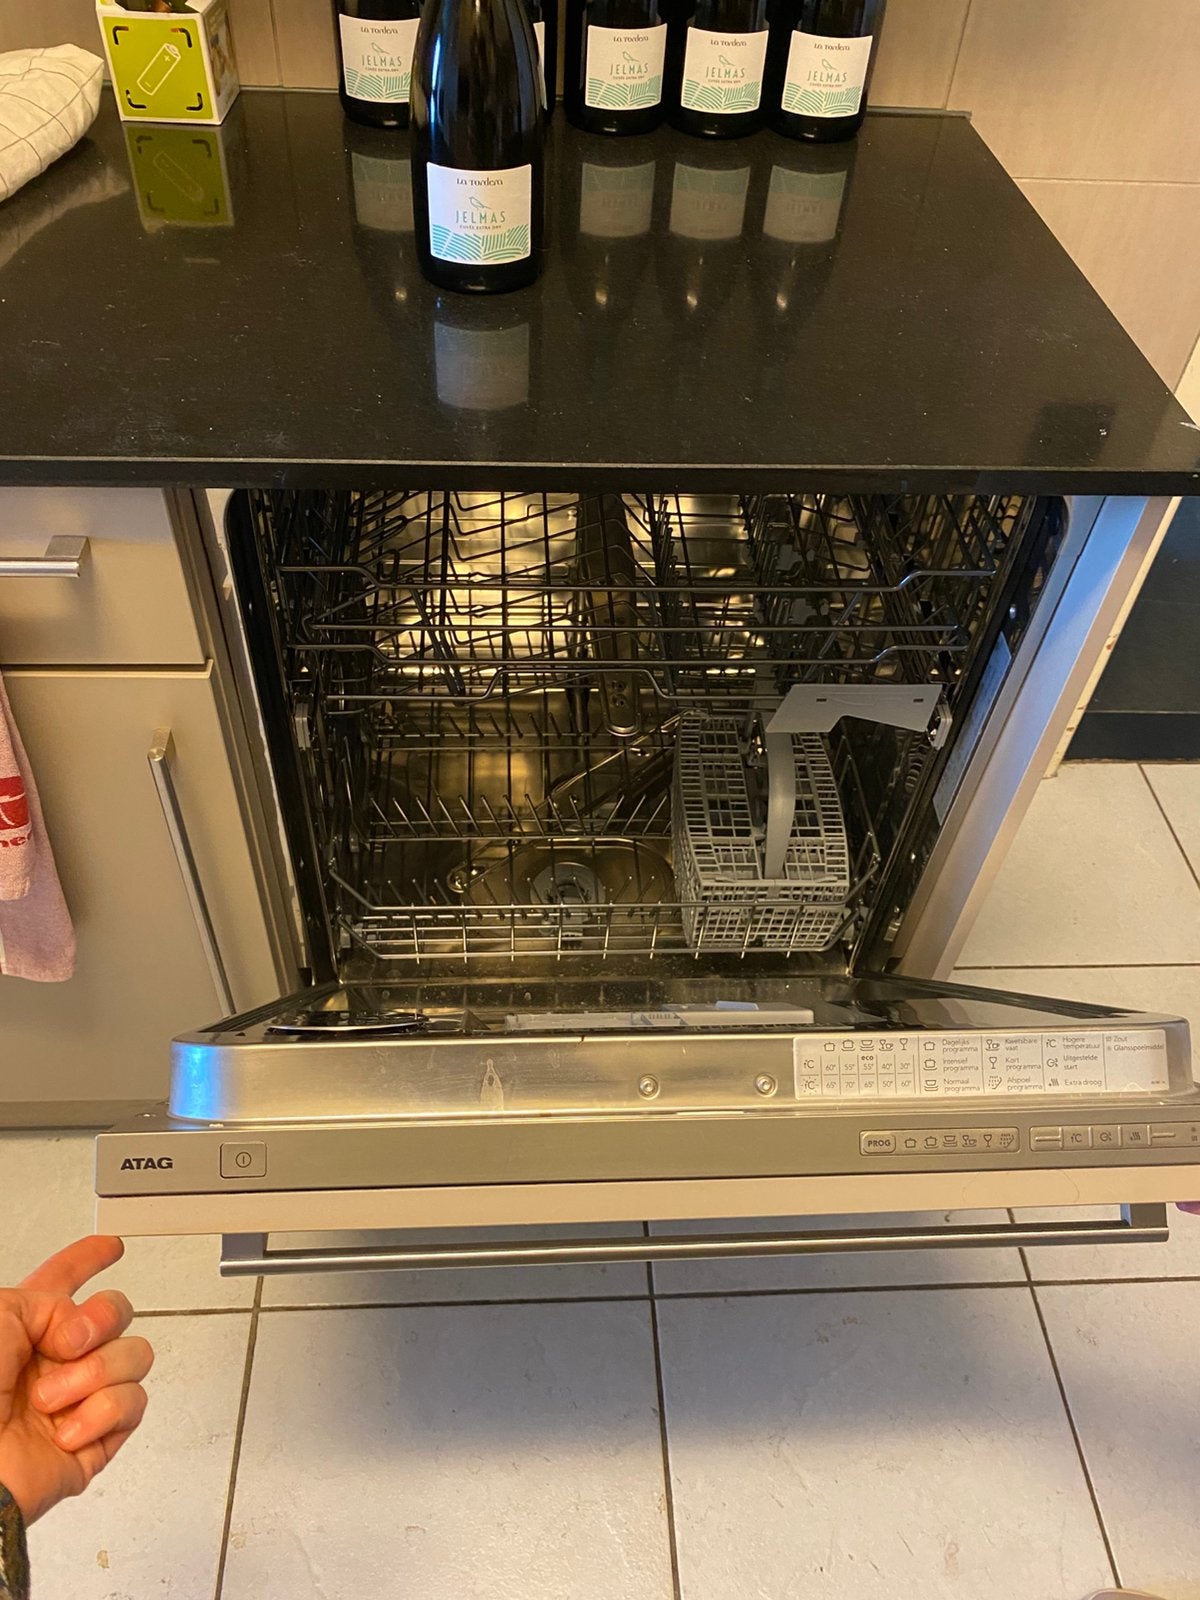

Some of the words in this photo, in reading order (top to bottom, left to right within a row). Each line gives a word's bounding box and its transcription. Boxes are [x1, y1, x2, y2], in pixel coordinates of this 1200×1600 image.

[361, 54, 402, 67] JELMAS
[610, 62, 649, 76] JELMAS
[705, 66, 745, 79] JELMAS
[807, 70, 848, 83] JELMAS
[456, 210, 506, 224] JELMAS
[942, 1046, 979, 1054] programma
[943, 1065, 979, 1073] programma
[1005, 1064, 1042, 1072] programma
[944, 1085, 980, 1093] programma
[1007, 1084, 1043, 1092] programma
[867, 1139, 891, 1147] PROG
[120, 1157, 173, 1170] ATAG
